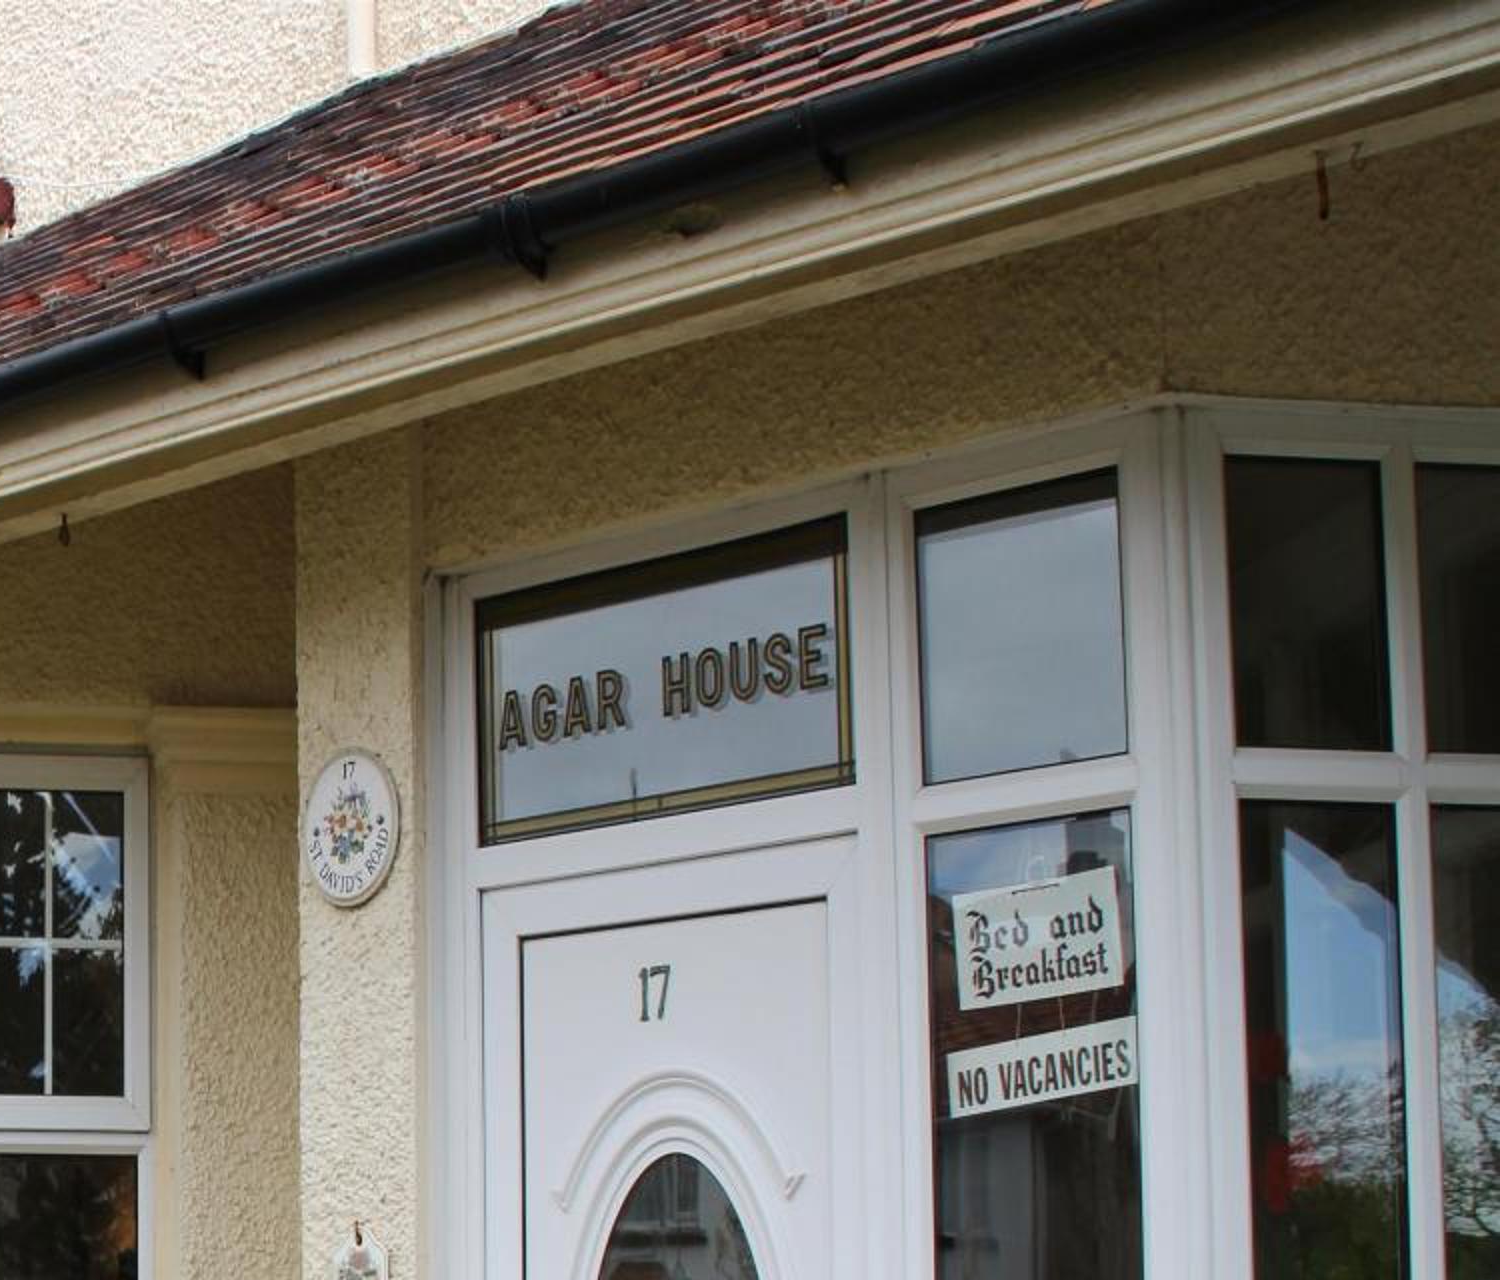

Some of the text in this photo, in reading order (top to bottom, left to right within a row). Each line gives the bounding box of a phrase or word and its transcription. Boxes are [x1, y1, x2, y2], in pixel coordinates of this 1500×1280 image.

[498, 622, 832, 752] AGAR HOUSE
[341, 760, 357, 780] 17
[967, 896, 1105, 954] Bed and
[638, 964, 671, 1023] 17
[969, 941, 1110, 1000] Breakfast
[957, 1038, 1133, 1110] NO VACANCIES
